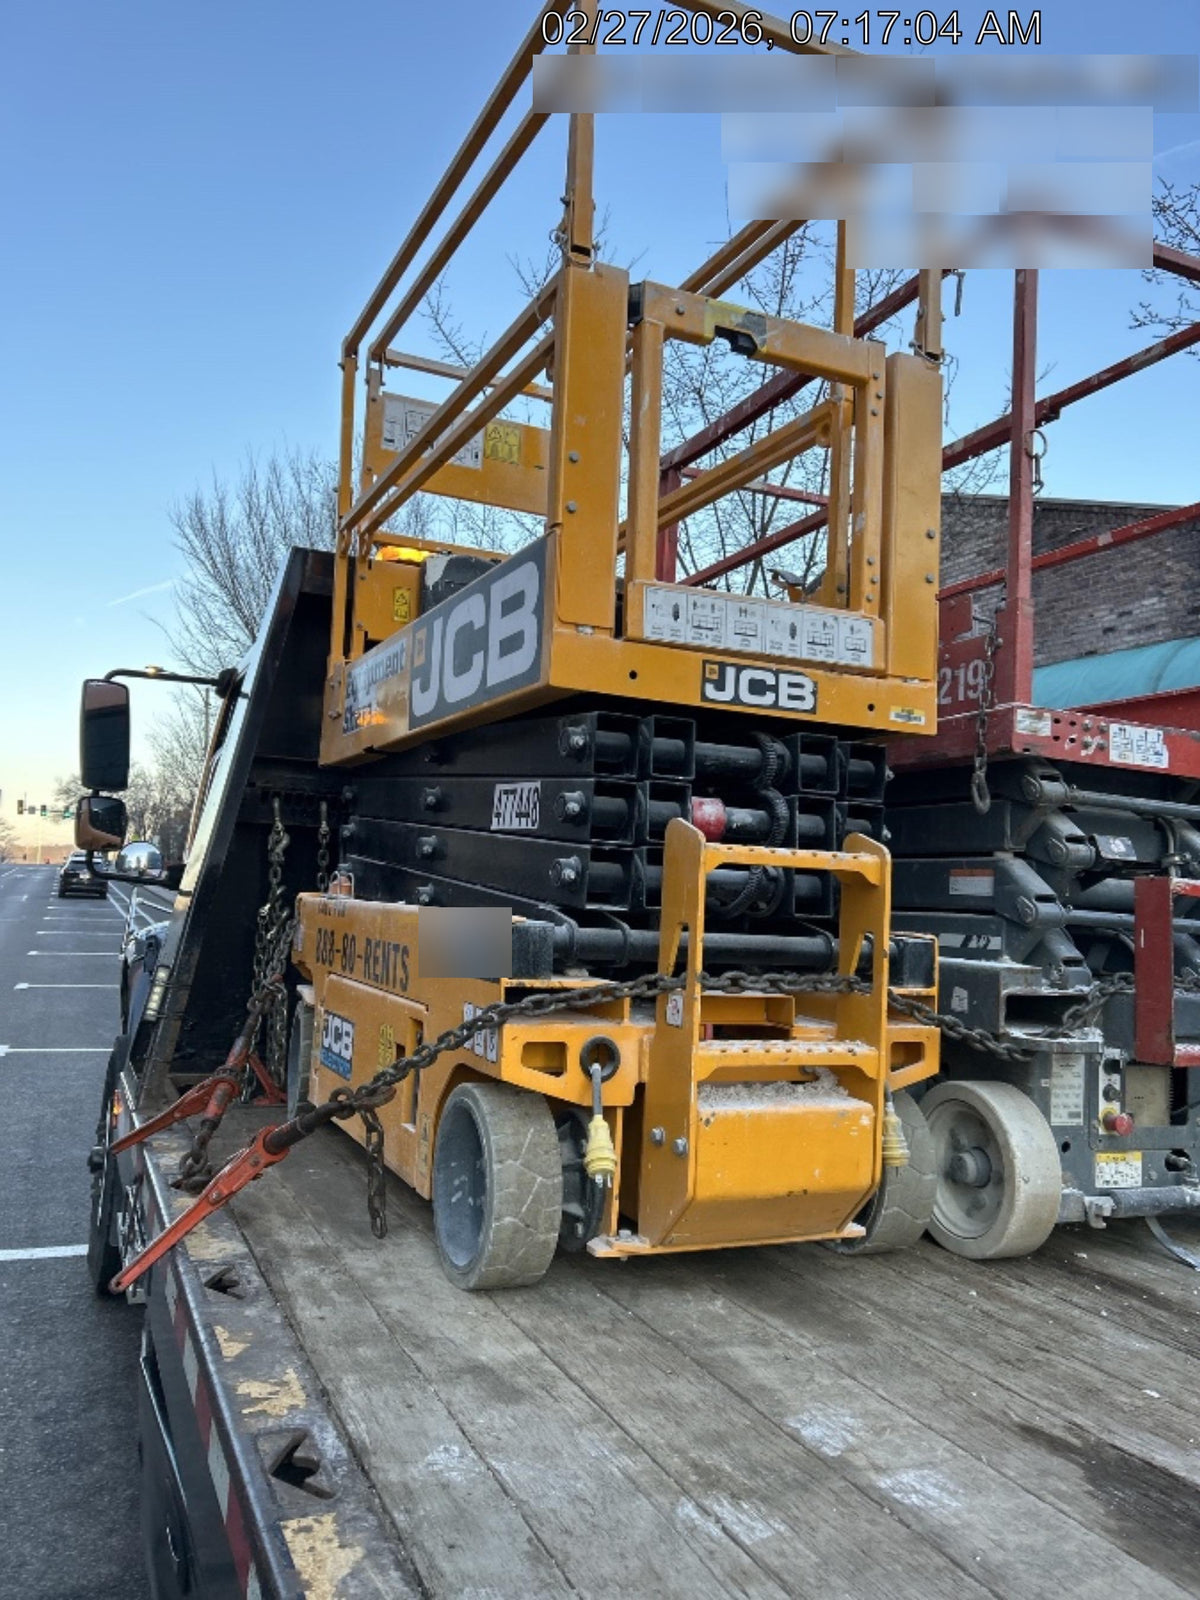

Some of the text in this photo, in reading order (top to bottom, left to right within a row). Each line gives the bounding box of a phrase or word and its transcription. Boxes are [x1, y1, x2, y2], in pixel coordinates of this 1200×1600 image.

[412, 561, 539, 717] JCB
[704, 665, 815, 711] JCB
[323, 1014, 352, 1061] JCB
